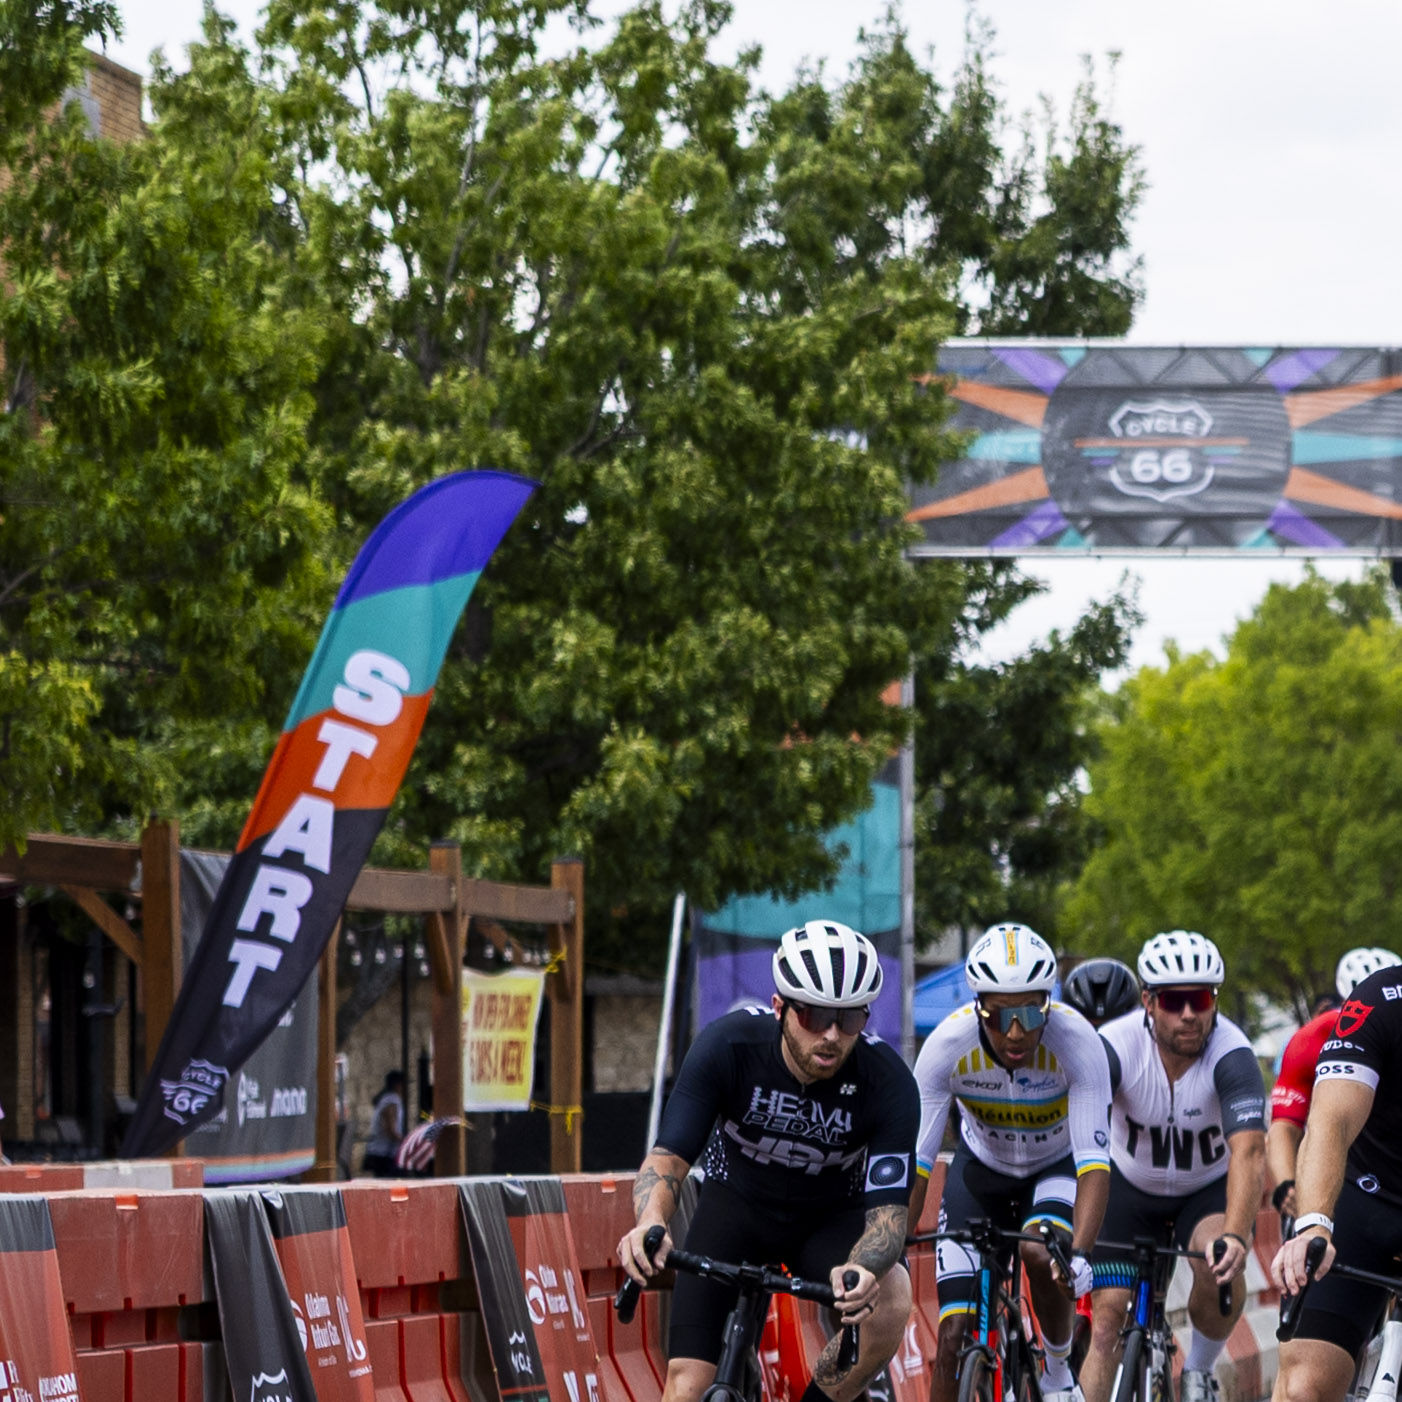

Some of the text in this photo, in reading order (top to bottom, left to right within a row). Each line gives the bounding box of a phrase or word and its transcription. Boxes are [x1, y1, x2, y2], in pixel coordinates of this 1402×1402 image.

[1125, 415, 1197, 437] CYCLE
[1131, 449, 1192, 483] 66
[223, 649, 410, 1009] START
[1316, 1065, 1355, 1076] OSS
[1125, 1114, 1227, 1171] TWC
